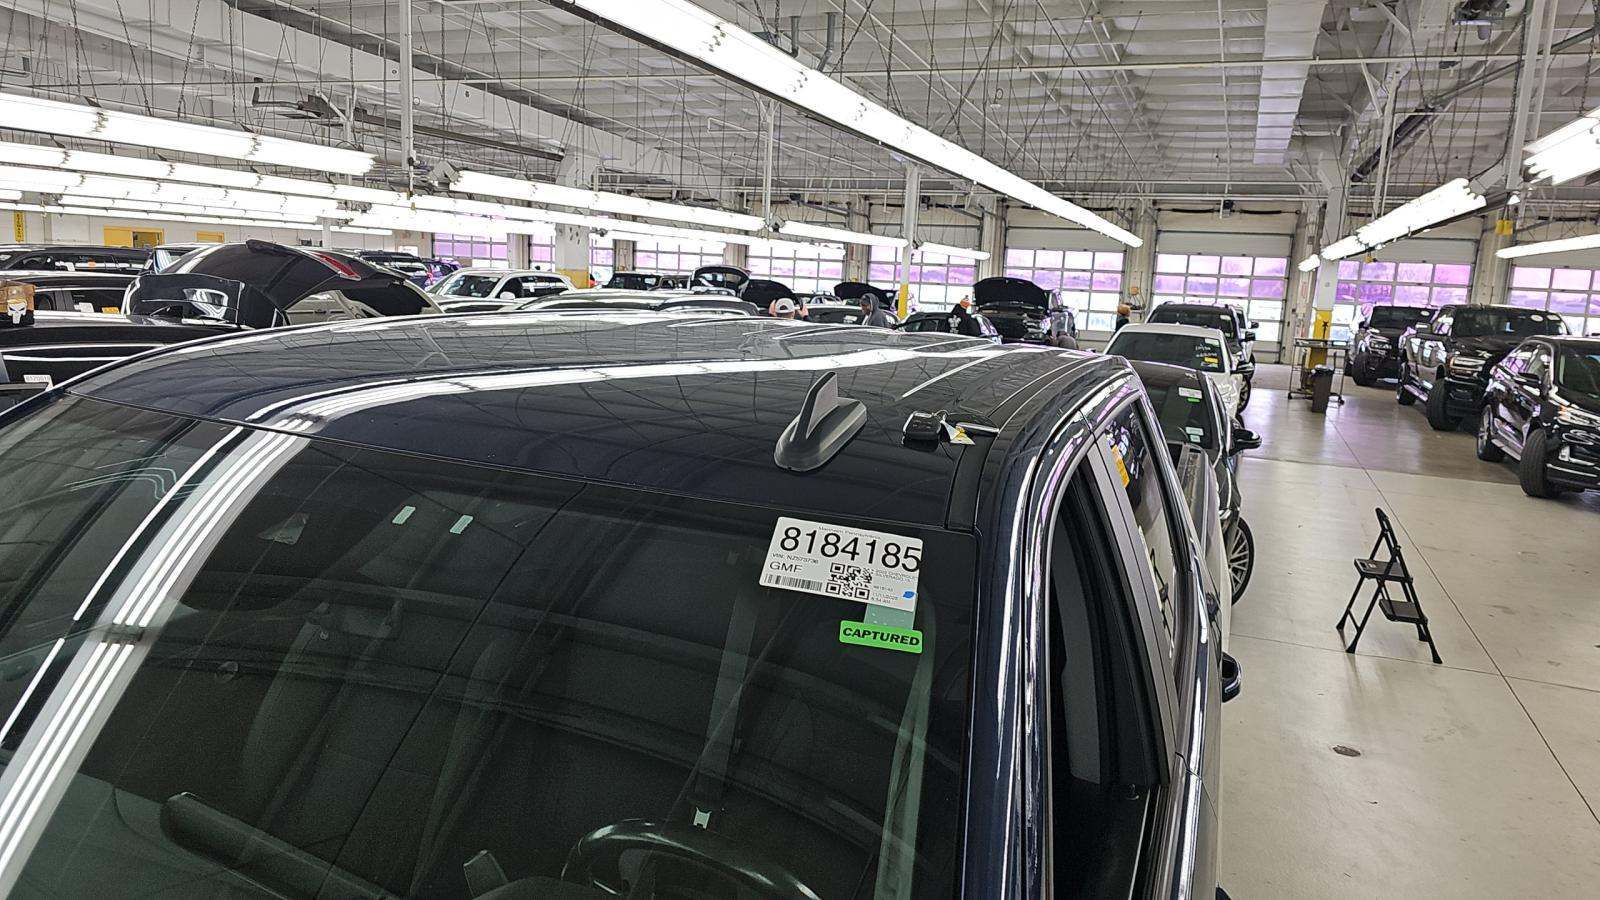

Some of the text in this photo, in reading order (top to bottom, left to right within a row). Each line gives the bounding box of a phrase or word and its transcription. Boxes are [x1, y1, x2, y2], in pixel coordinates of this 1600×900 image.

[780, 526, 922, 572] 8184185
[769, 561, 803, 572] GMF
[843, 627, 920, 646] CAPTURED
